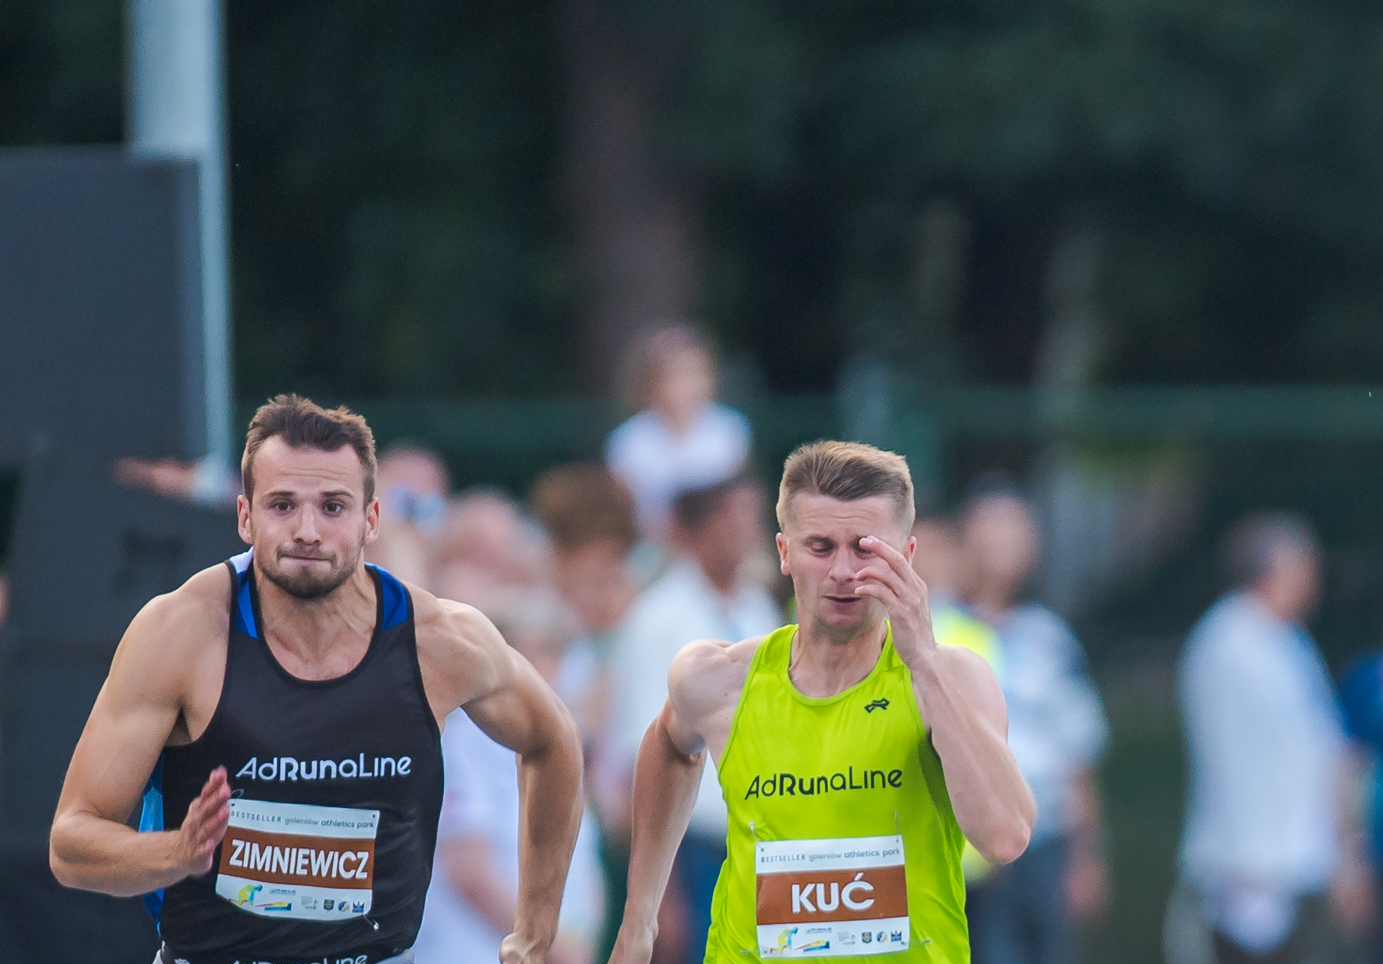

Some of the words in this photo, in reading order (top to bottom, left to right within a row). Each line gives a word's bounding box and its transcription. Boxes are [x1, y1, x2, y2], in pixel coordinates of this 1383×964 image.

[230, 810, 282, 823] BESTSELLER
[284, 816, 320, 826] goleniów
[321, 818, 355, 828] athletics
[356, 821, 375, 830] park
[229, 839, 369, 879] ZIMNIEWICZ
[760, 854, 806, 863] BESTSELLER
[844, 850, 880, 859] athletics
[882, 848, 901, 858] park
[791, 872, 875, 913] KUĆ
